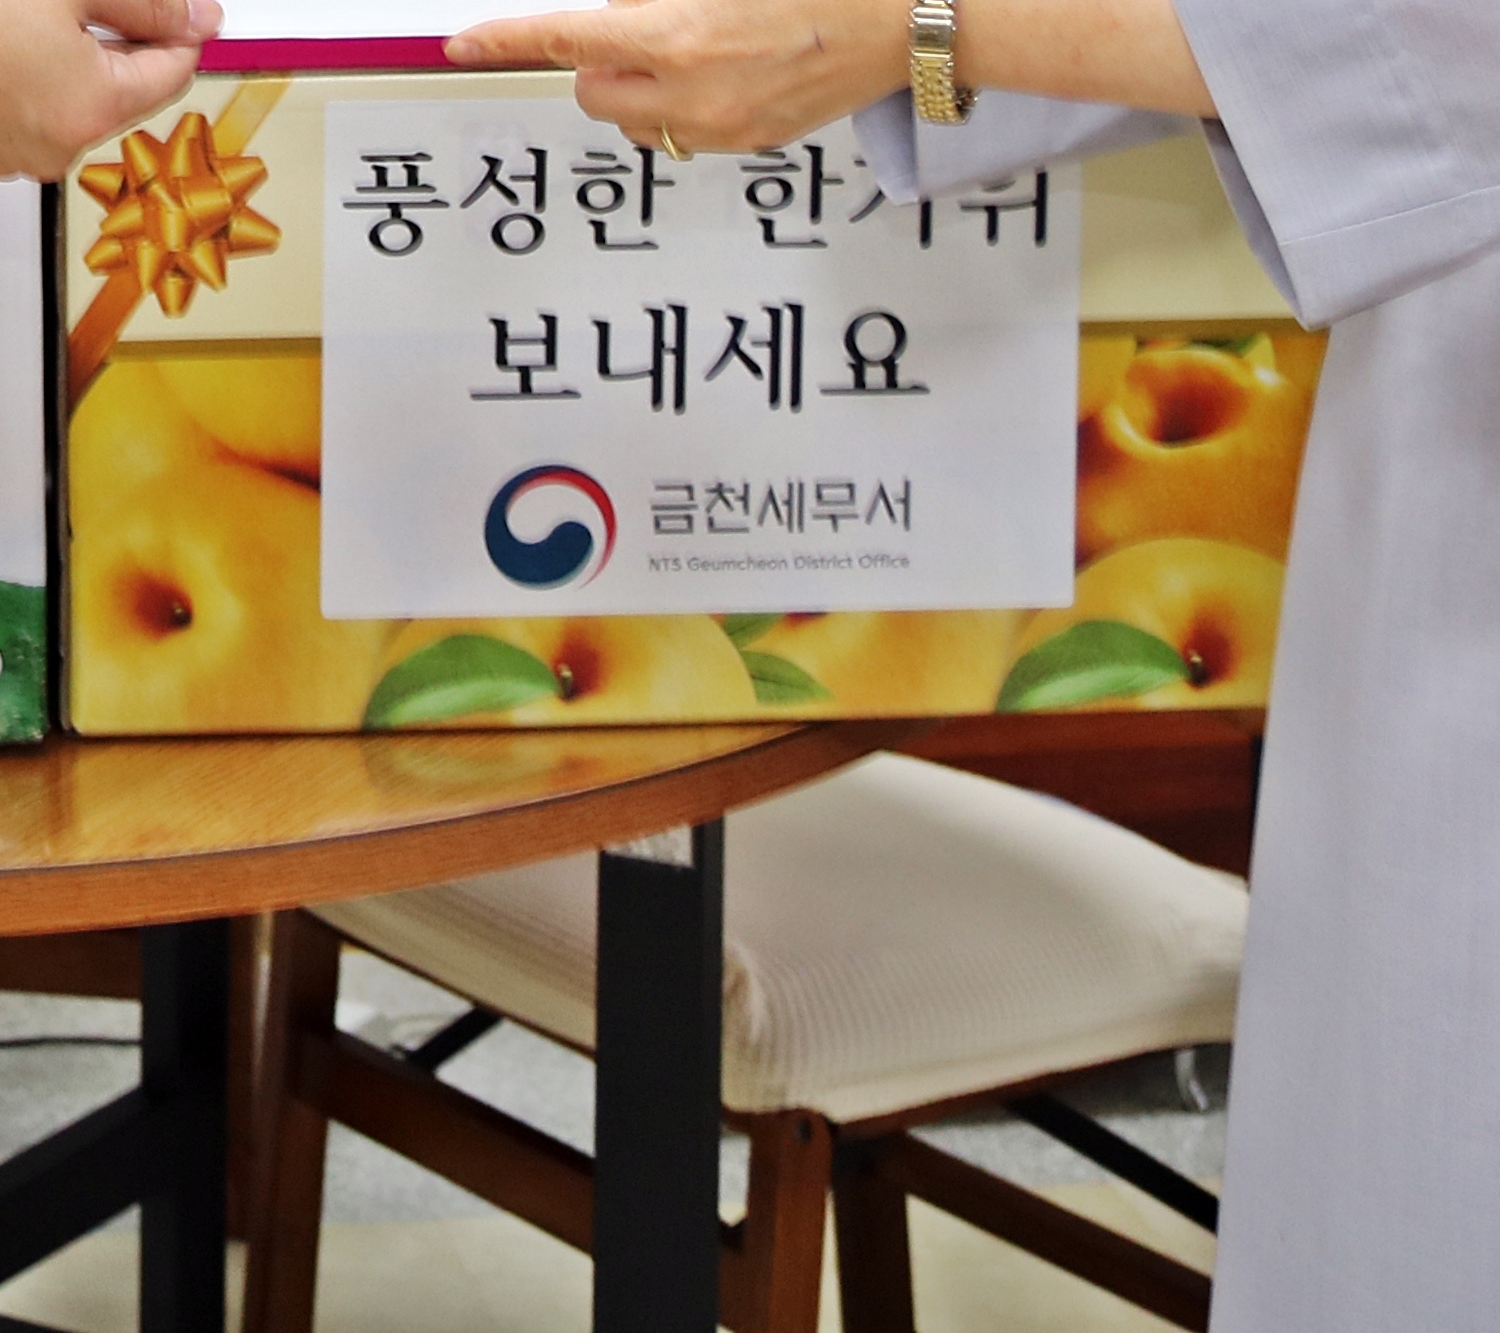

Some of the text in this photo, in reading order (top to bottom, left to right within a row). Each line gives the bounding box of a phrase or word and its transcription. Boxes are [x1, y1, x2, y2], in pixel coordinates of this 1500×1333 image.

[342, 146, 675, 255] 풍성한
[471, 301, 930, 413] 보내세요
[650, 479, 912, 534] 금천세무서
[650, 553, 911, 572] NTS Geumcheon District Office
